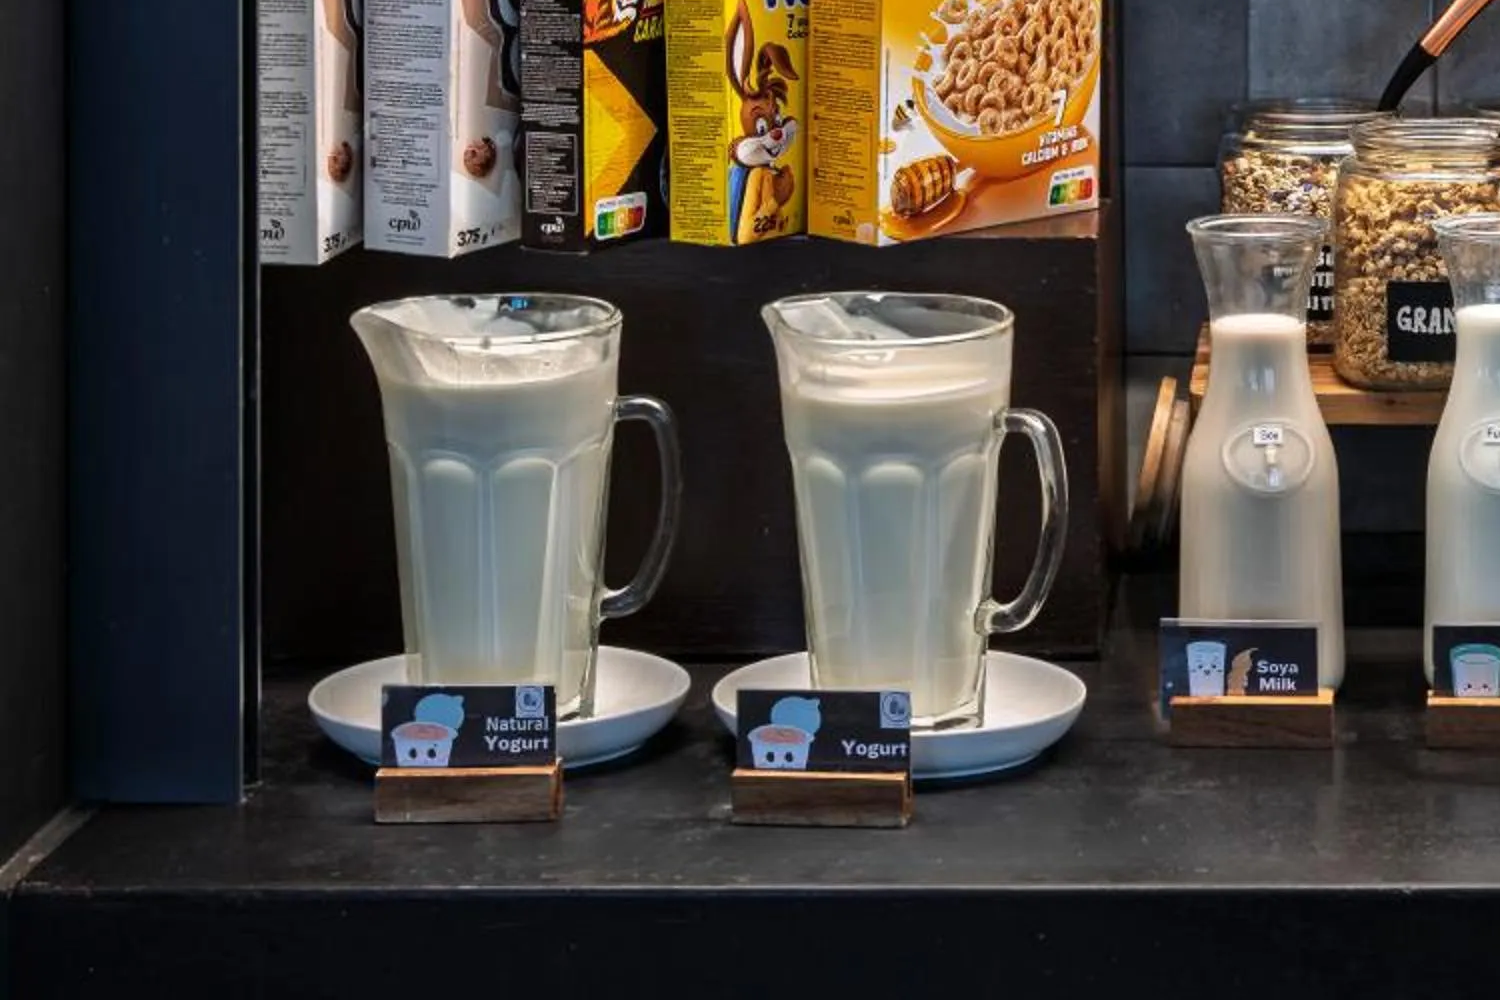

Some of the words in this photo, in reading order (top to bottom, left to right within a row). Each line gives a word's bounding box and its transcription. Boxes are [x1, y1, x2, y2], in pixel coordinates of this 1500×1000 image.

[1053, 89, 1067, 126] 7
[1396, 304, 1457, 334] GRAN
[1256, 659, 1299, 676] Soya
[1258, 677, 1297, 692] Milk
[486, 715, 549, 731] Natural
[484, 735, 549, 753] Yogurt
[841, 739, 908, 759] Yogurt
